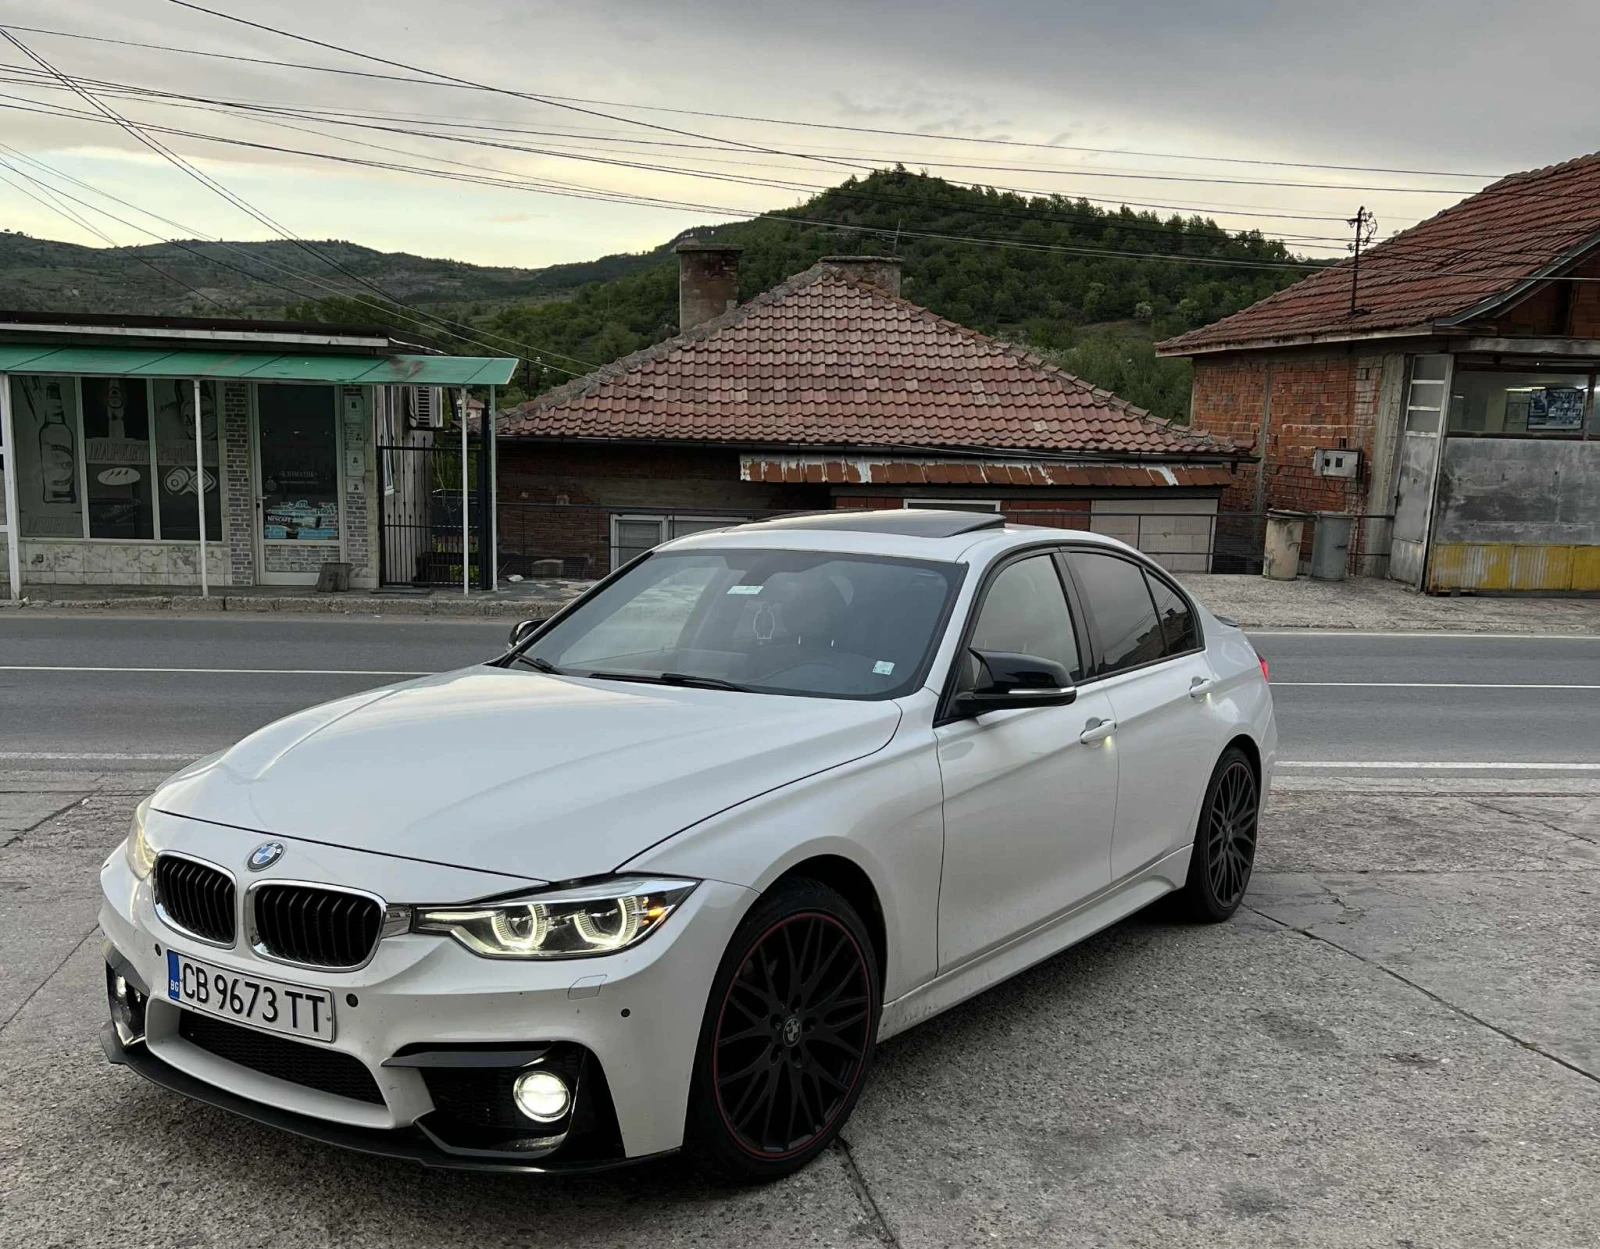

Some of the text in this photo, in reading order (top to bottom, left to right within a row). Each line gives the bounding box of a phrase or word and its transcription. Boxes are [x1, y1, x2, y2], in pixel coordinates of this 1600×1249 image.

[170, 979, 179, 992] BG
[182, 963, 325, 1032] CB 9673 TT
